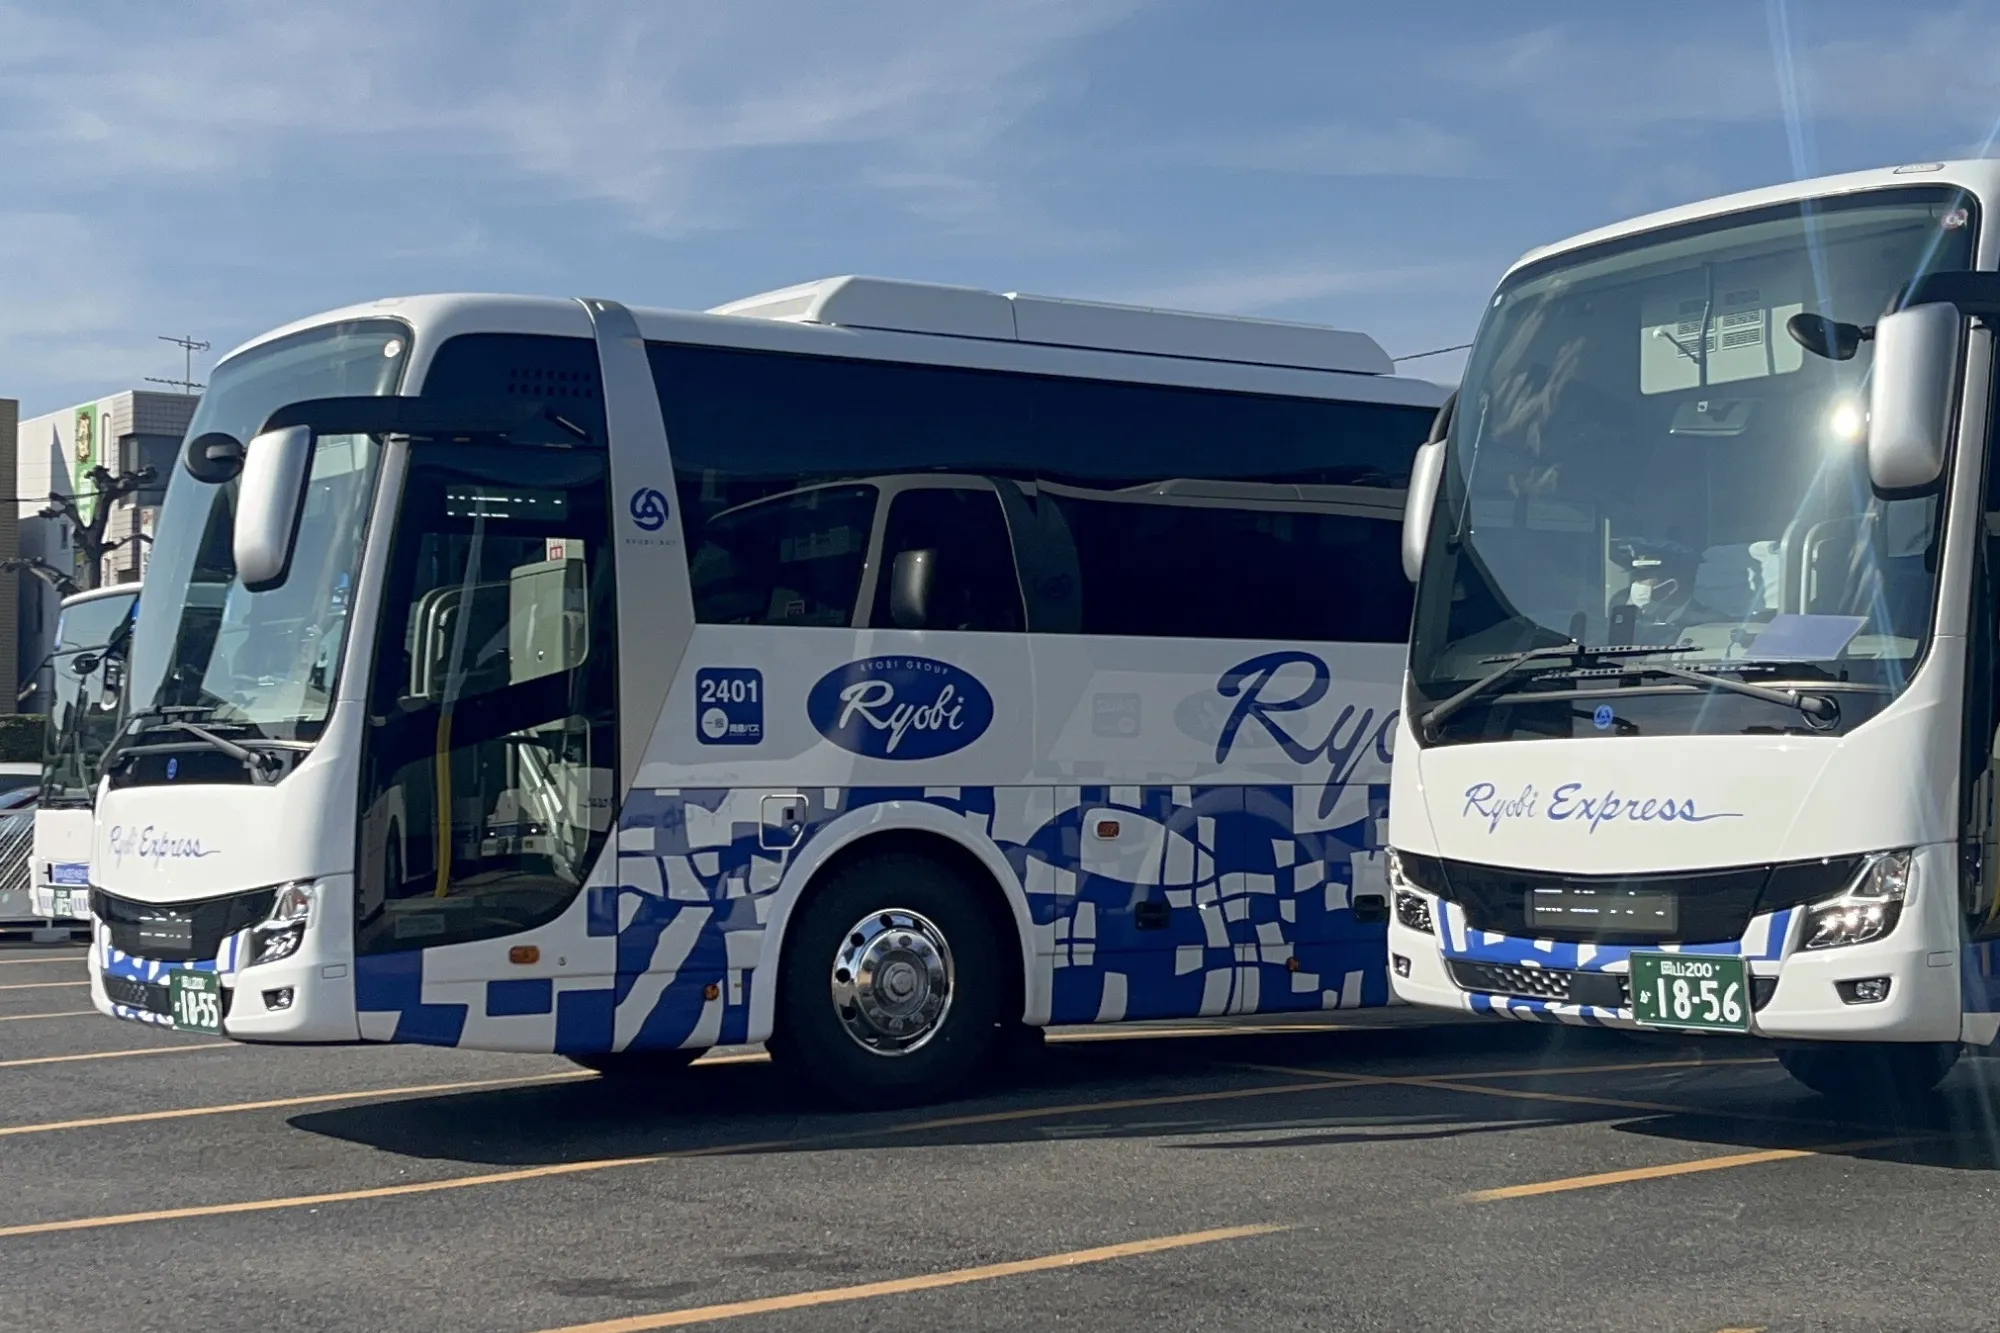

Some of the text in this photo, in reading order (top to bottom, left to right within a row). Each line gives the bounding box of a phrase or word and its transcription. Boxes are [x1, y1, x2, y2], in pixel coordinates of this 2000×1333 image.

[861, 660, 949, 675] RYOBI GROUP
[701, 679, 758, 703] 2401
[839, 680, 965, 754] Ryobi
[1463, 782, 1744, 835] Ryobi Express
[139, 825, 222, 869] Express
[180, 990, 219, 1028] 18-55
[1656, 977, 1742, 1023] 18-56
